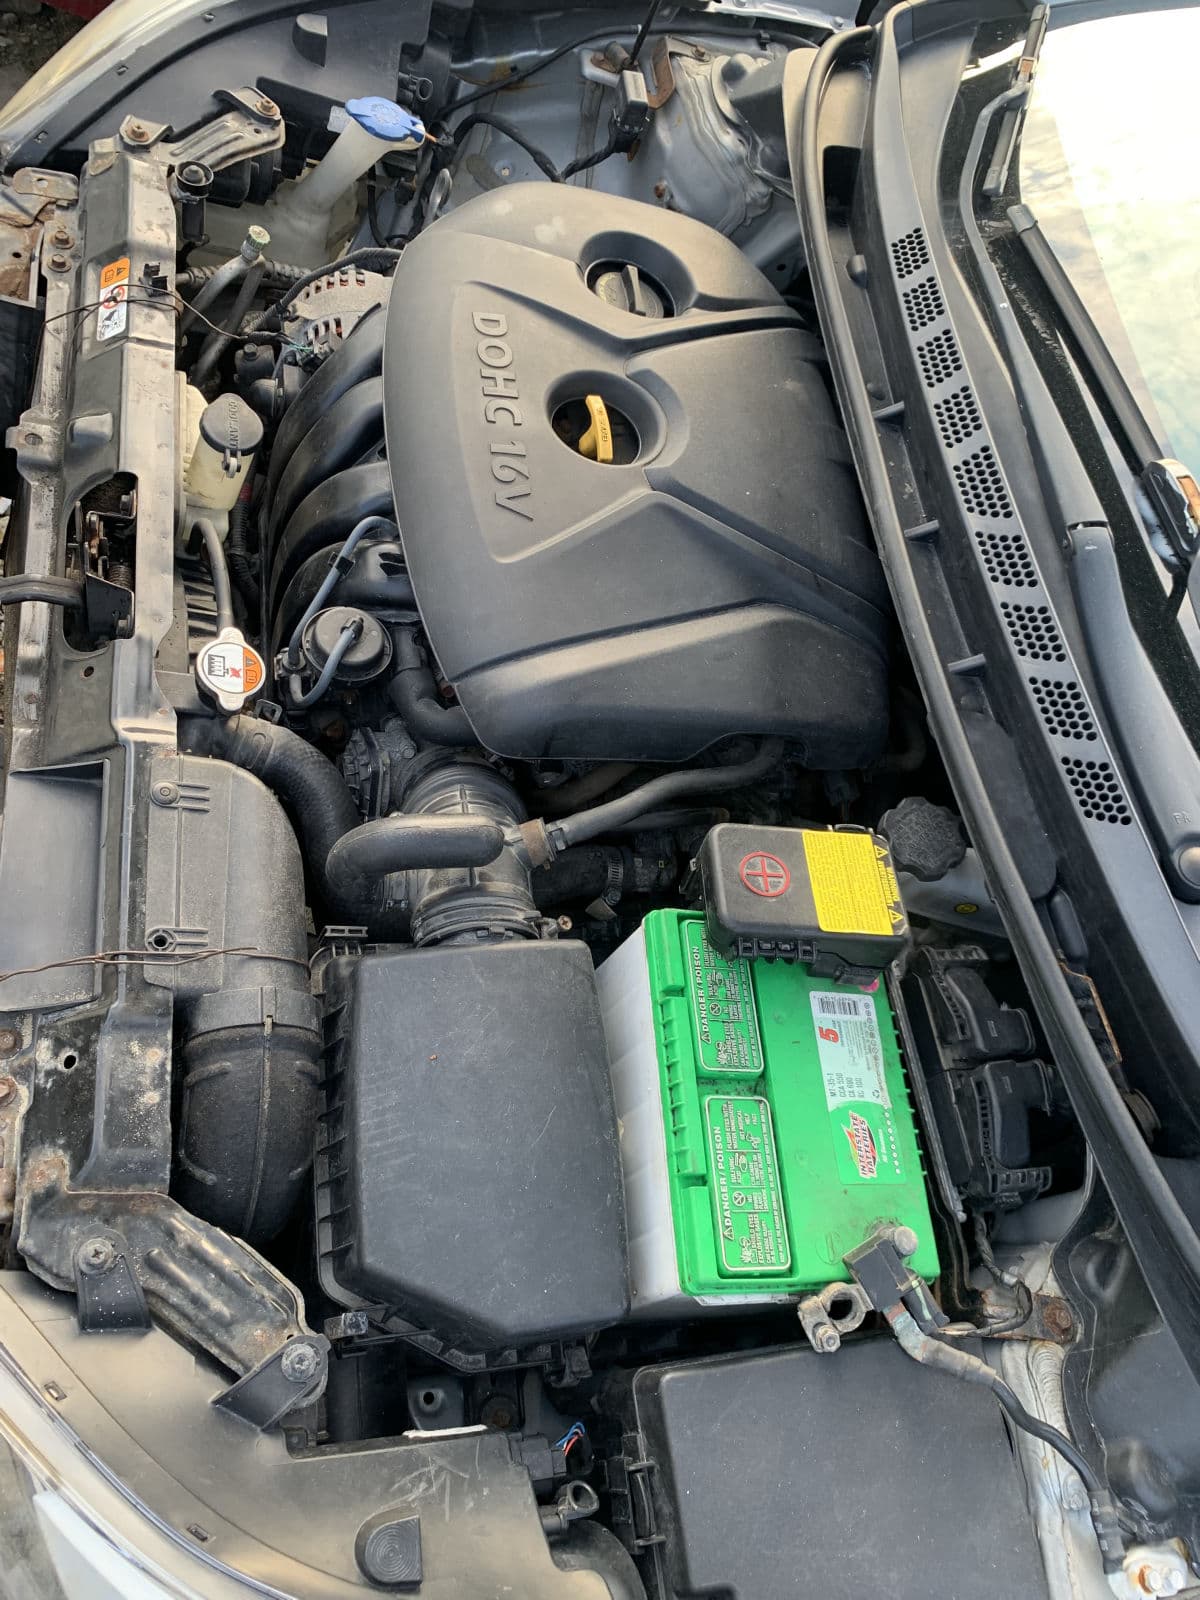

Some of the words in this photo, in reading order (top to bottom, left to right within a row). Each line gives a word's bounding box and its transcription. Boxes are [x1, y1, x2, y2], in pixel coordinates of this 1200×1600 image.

[472, 311, 523, 426] DOHC
[228, 400, 240, 449] COOLANT
[489, 440, 534, 522] 16V
[818, 1026, 839, 1043] 5
[851, 1115, 868, 1176] INTERSTATE
[860, 1119, 875, 1174] BATTERIES
